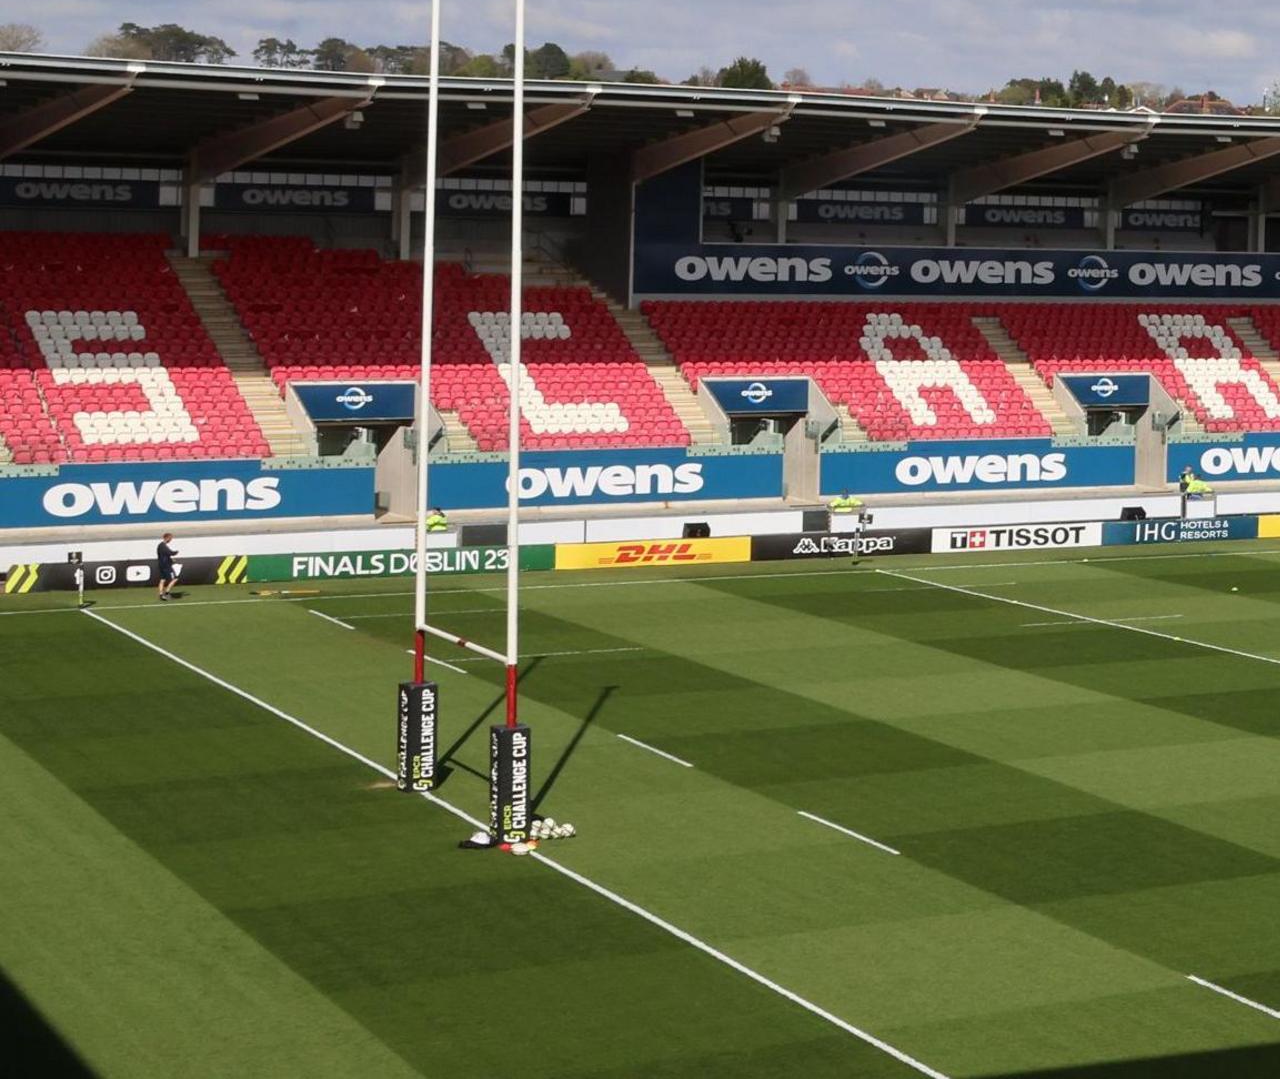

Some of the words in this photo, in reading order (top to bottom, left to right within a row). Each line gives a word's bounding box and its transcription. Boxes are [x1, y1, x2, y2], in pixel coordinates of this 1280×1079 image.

[16, 181, 132, 201] owens
[242, 186, 349, 207] owens
[818, 203, 904, 220] owens
[985, 208, 1065, 224] owens
[674, 255, 833, 282] owens
[844, 262, 900, 277] owens
[910, 257, 1055, 285] owens
[1067, 266, 1119, 281] owens
[1128, 262, 1262, 288] owens
[336, 394, 373, 403] owens
[740, 390, 773, 398] owens
[1091, 385, 1118, 393] owens
[895, 452, 1067, 485] owens
[505, 462, 703, 500] owens
[43, 477, 281, 517] owens
[1135, 522, 1176, 542] IHG
[1180, 521, 1219, 531] HOTELS
[1220, 520, 1229, 529] &
[1180, 529, 1229, 540] RESORTS
[821, 536, 894, 554] Kappa
[990, 526, 1085, 546] TISSOT
[614, 543, 697, 563] DHL
[292, 554, 384, 579] FINALS
[484, 550, 510, 570] 23
[422, 689, 434, 712] CUP
[421, 713, 434, 778] CHALLENGE
[512, 732, 527, 757] CUP
[413, 755, 421, 780] EPCR
[512, 758, 527, 829] CHALLENGE
[503, 805, 512, 830] EPCR
